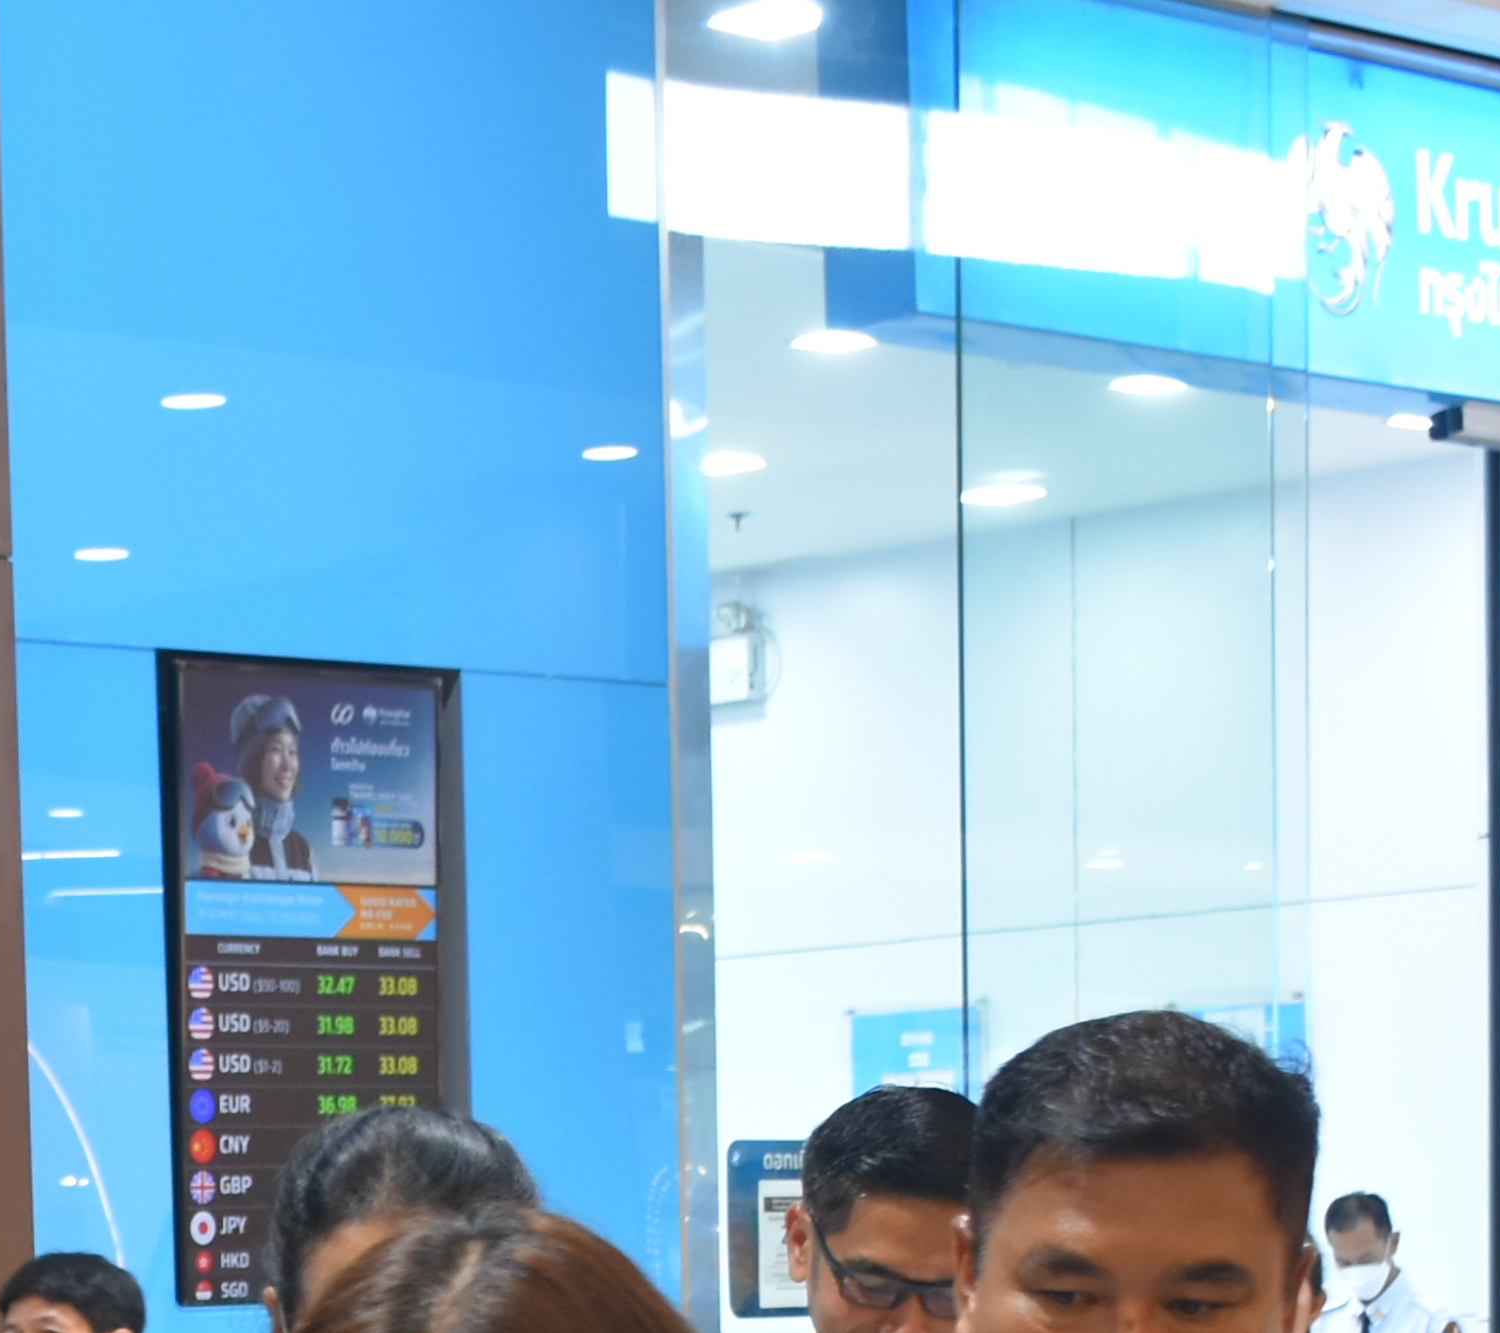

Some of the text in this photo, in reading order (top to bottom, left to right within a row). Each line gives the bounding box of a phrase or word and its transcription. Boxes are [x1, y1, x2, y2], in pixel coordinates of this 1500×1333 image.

[217, 942, 261, 955] CURRENCY
[316, 944, 340, 957] BANK
[341, 945, 359, 958] BUY
[378, 946, 400, 958] BANK
[218, 972, 250, 992] USD
[316, 974, 356, 995] 32.47
[378, 976, 418, 997] 33.08
[218, 1013, 418, 1036] USD ($5-20) 31.98 33.08
[218, 1054, 251, 1074] USD
[316, 1056, 354, 1075] 31.72
[378, 1056, 418, 1076] 33.08
[219, 1095, 251, 1114] EUR
[219, 1136, 250, 1154] CNY
[220, 1176, 252, 1195] GBP
[220, 1216, 247, 1235] JPY
[221, 1251, 249, 1269] HKD
[220, 1282, 249, 1298] SGD
